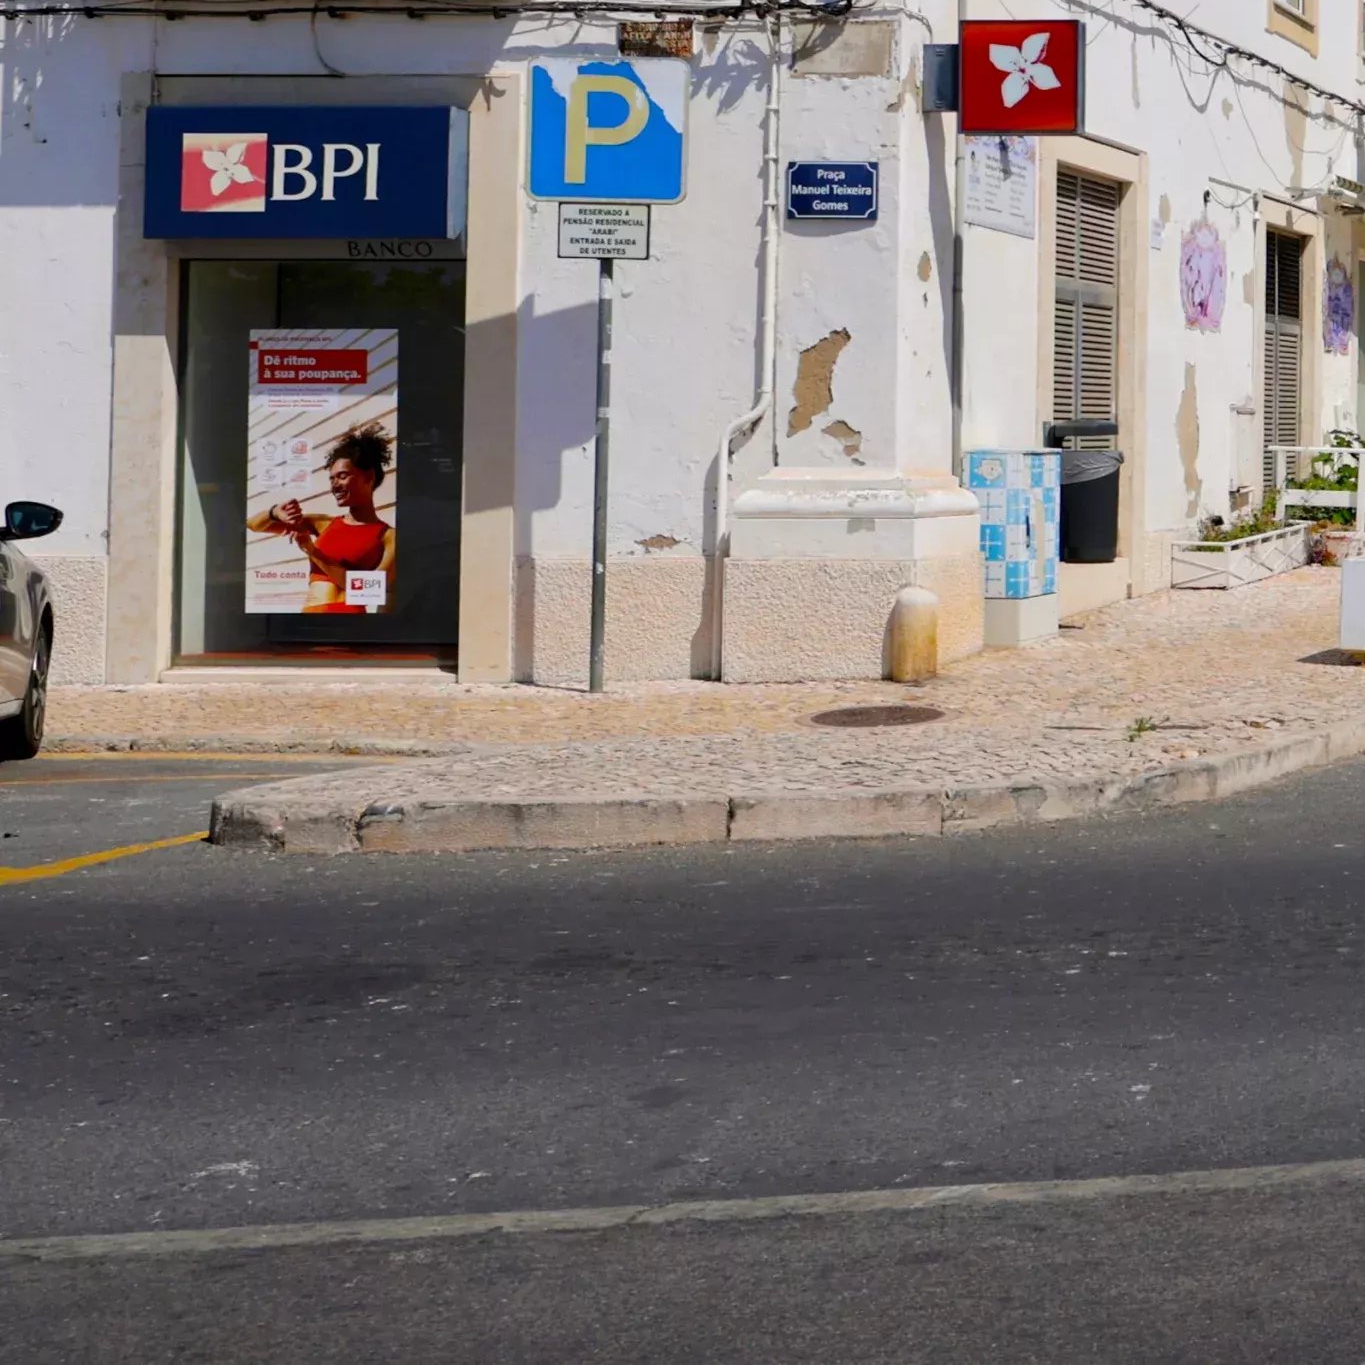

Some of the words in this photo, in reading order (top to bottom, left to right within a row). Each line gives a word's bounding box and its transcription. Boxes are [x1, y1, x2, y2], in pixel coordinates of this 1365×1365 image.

[564, 74, 650, 184] P
[270, 143, 382, 201] BPI
[817, 169, 845, 181] Praça
[792, 184, 830, 195] Manuel
[832, 184, 872, 195] Teixeira
[812, 200, 849, 211] Gomes
[578, 208, 623, 216] RESERVADO
[563, 217, 593, 225] PENSÃO
[595, 218, 644, 226] RESIDENCIAL
[569, 237, 605, 245] ENTRADA
[347, 240, 433, 257] BANCO
[591, 247, 626, 255] UTENTES
[263, 355, 281, 366] Dê
[283, 355, 317, 366] ritmo
[263, 368, 271, 379] à
[273, 370, 295, 379] sua
[298, 369, 362, 381] poupança.
[255, 570, 277, 579] Tudo
[280, 570, 306, 579] conta
[364, 579, 382, 589] BPI
